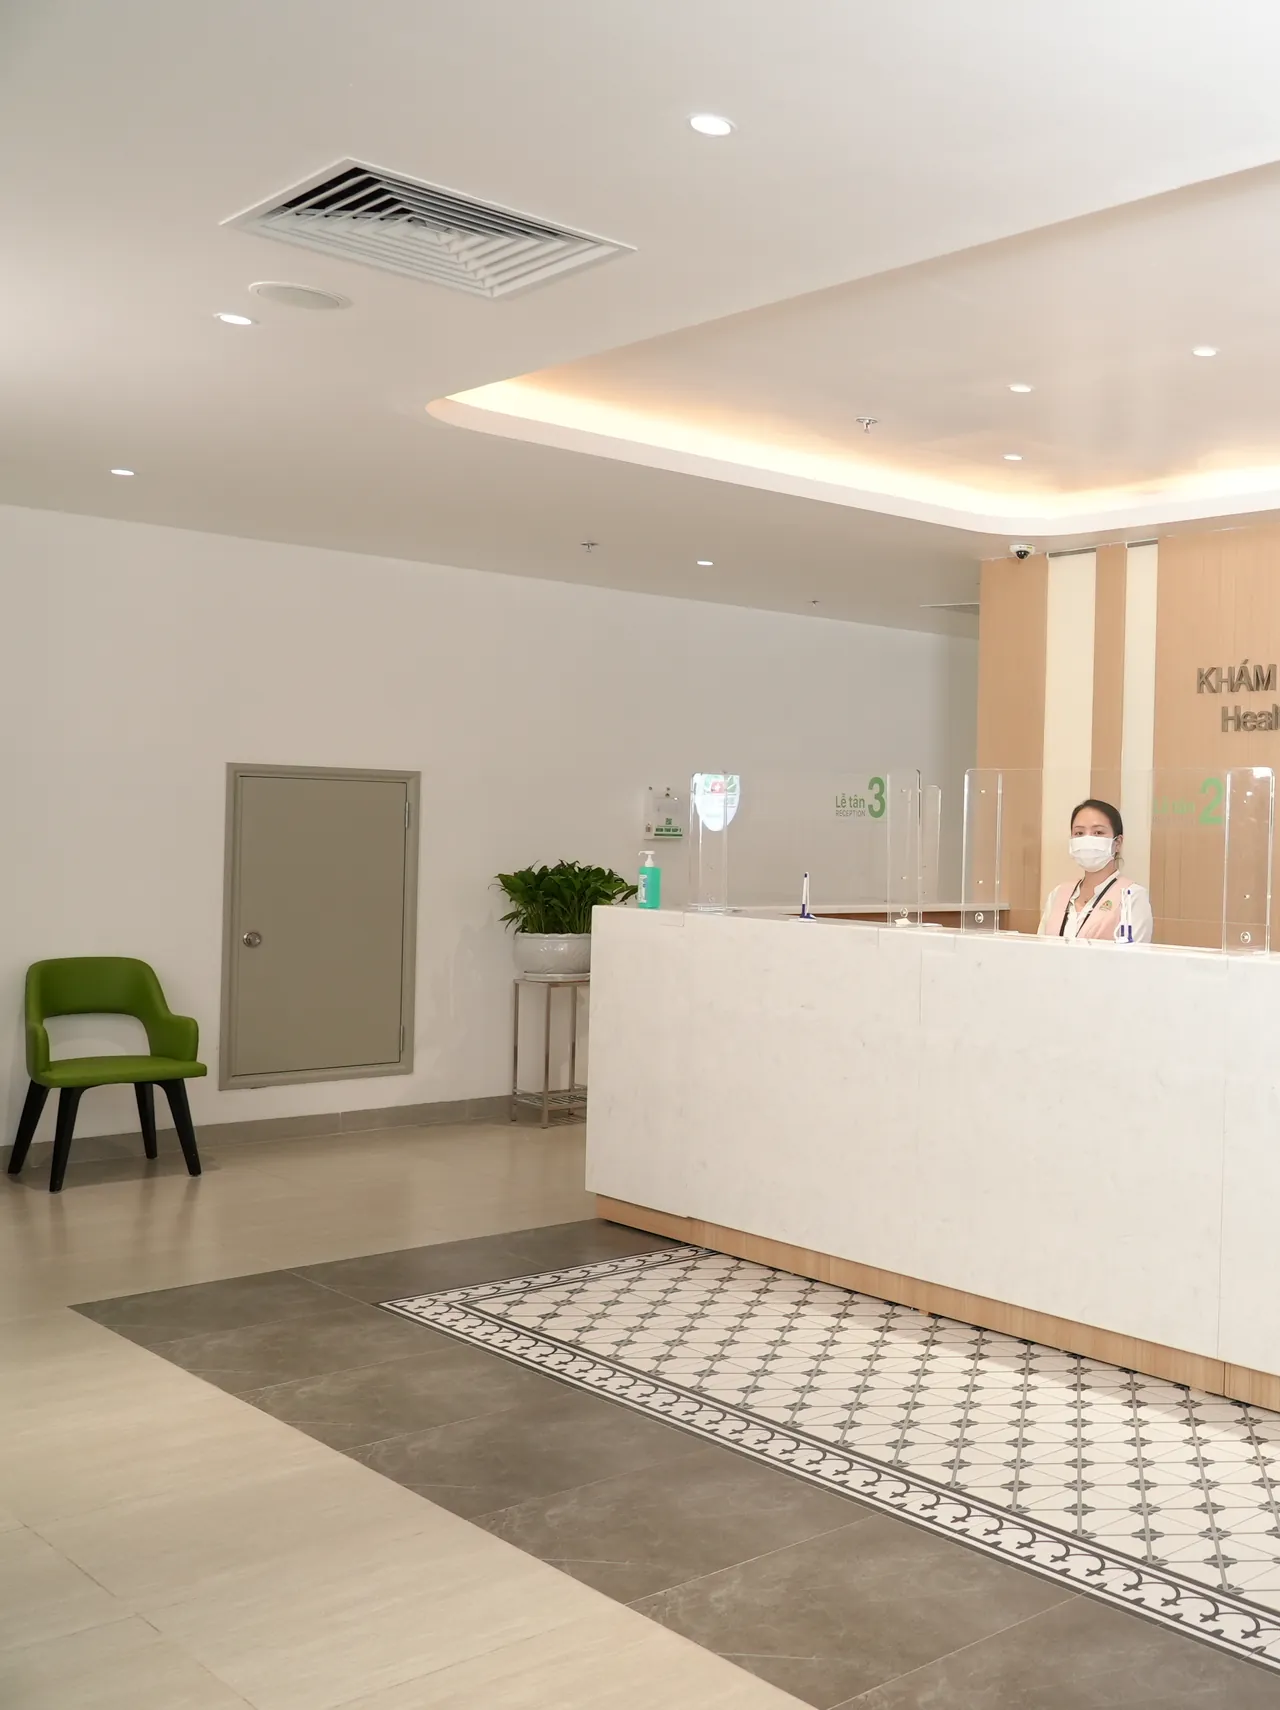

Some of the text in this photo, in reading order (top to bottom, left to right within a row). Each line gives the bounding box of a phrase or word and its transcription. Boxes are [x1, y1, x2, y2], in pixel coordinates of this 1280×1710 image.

[1196, 658, 1277, 694] KHÁM
[835, 776, 886, 819] Lễ tân 3
[835, 809, 866, 818] RECEPTION
[1198, 777, 1225, 826] 2
